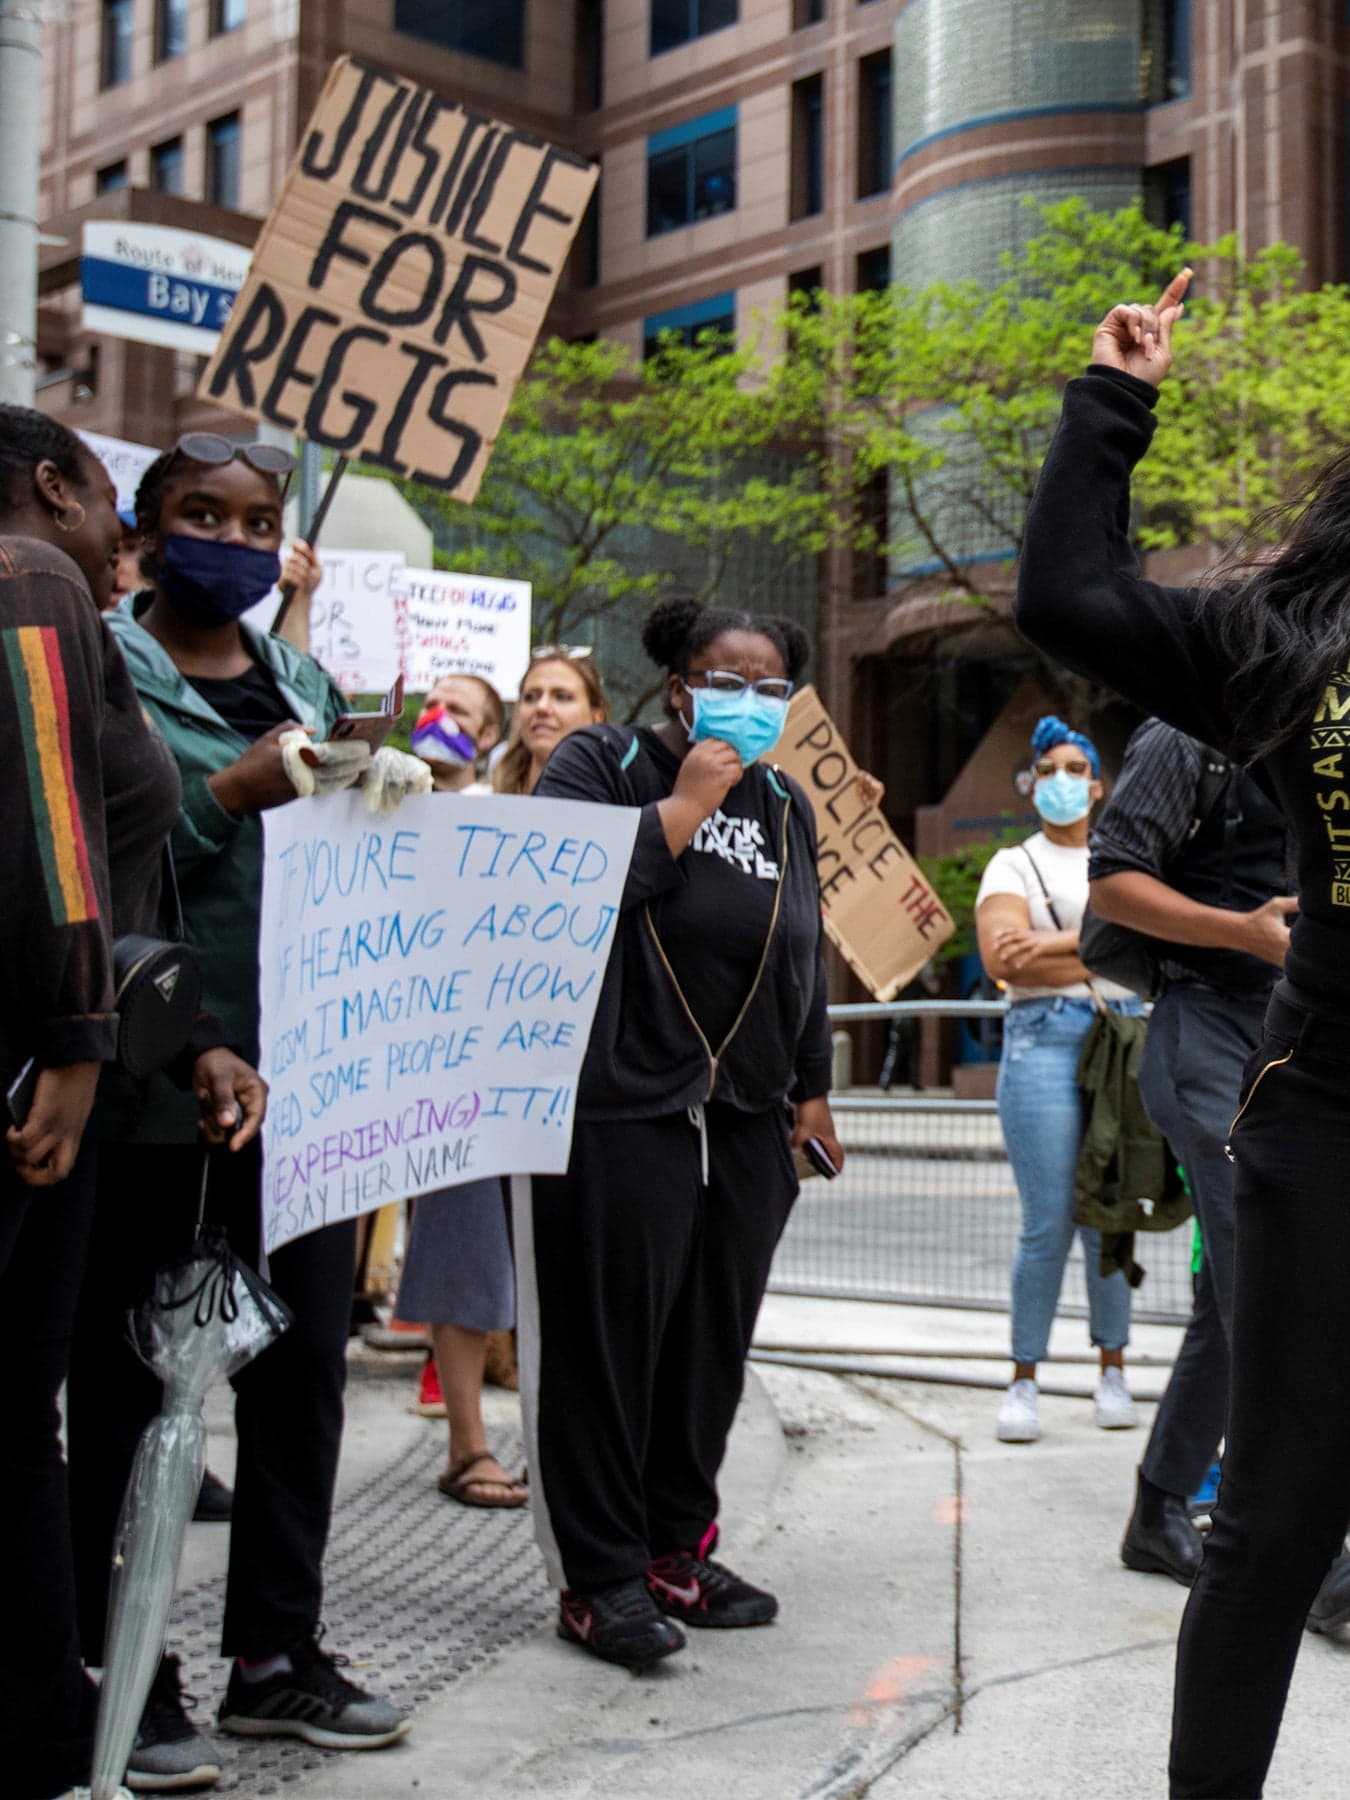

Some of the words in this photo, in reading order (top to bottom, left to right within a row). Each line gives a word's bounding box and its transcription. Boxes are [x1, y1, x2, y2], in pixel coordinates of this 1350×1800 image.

[302, 57, 593, 276] JUSTICE
[114, 238, 173, 267] Route
[147, 273, 210, 324] Bay
[308, 199, 518, 363] FOR
[208, 282, 498, 491] REGIS
[323, 557, 403, 597] TICE
[1313, 753, 1344, 778] A
[300, 831, 421, 917] YOU'RE
[457, 825, 608, 886] TIRED
[795, 719, 904, 881] POLICE
[898, 874, 948, 940] THE
[299, 910, 447, 992] HEARING
[462, 901, 620, 954] ABOUT
[314, 969, 472, 1059] IMAGINE
[487, 959, 597, 1011] HOW
[310, 1056, 372, 1120] SOME
[386, 1025, 484, 1092] PEOPLE
[498, 1020, 577, 1052] ARE
[481, 1086, 572, 1128] IT!!
[266, 1179, 330, 1243] #SAY
[341, 1159, 395, 1213] HER
[404, 1134, 479, 1190] NAME
